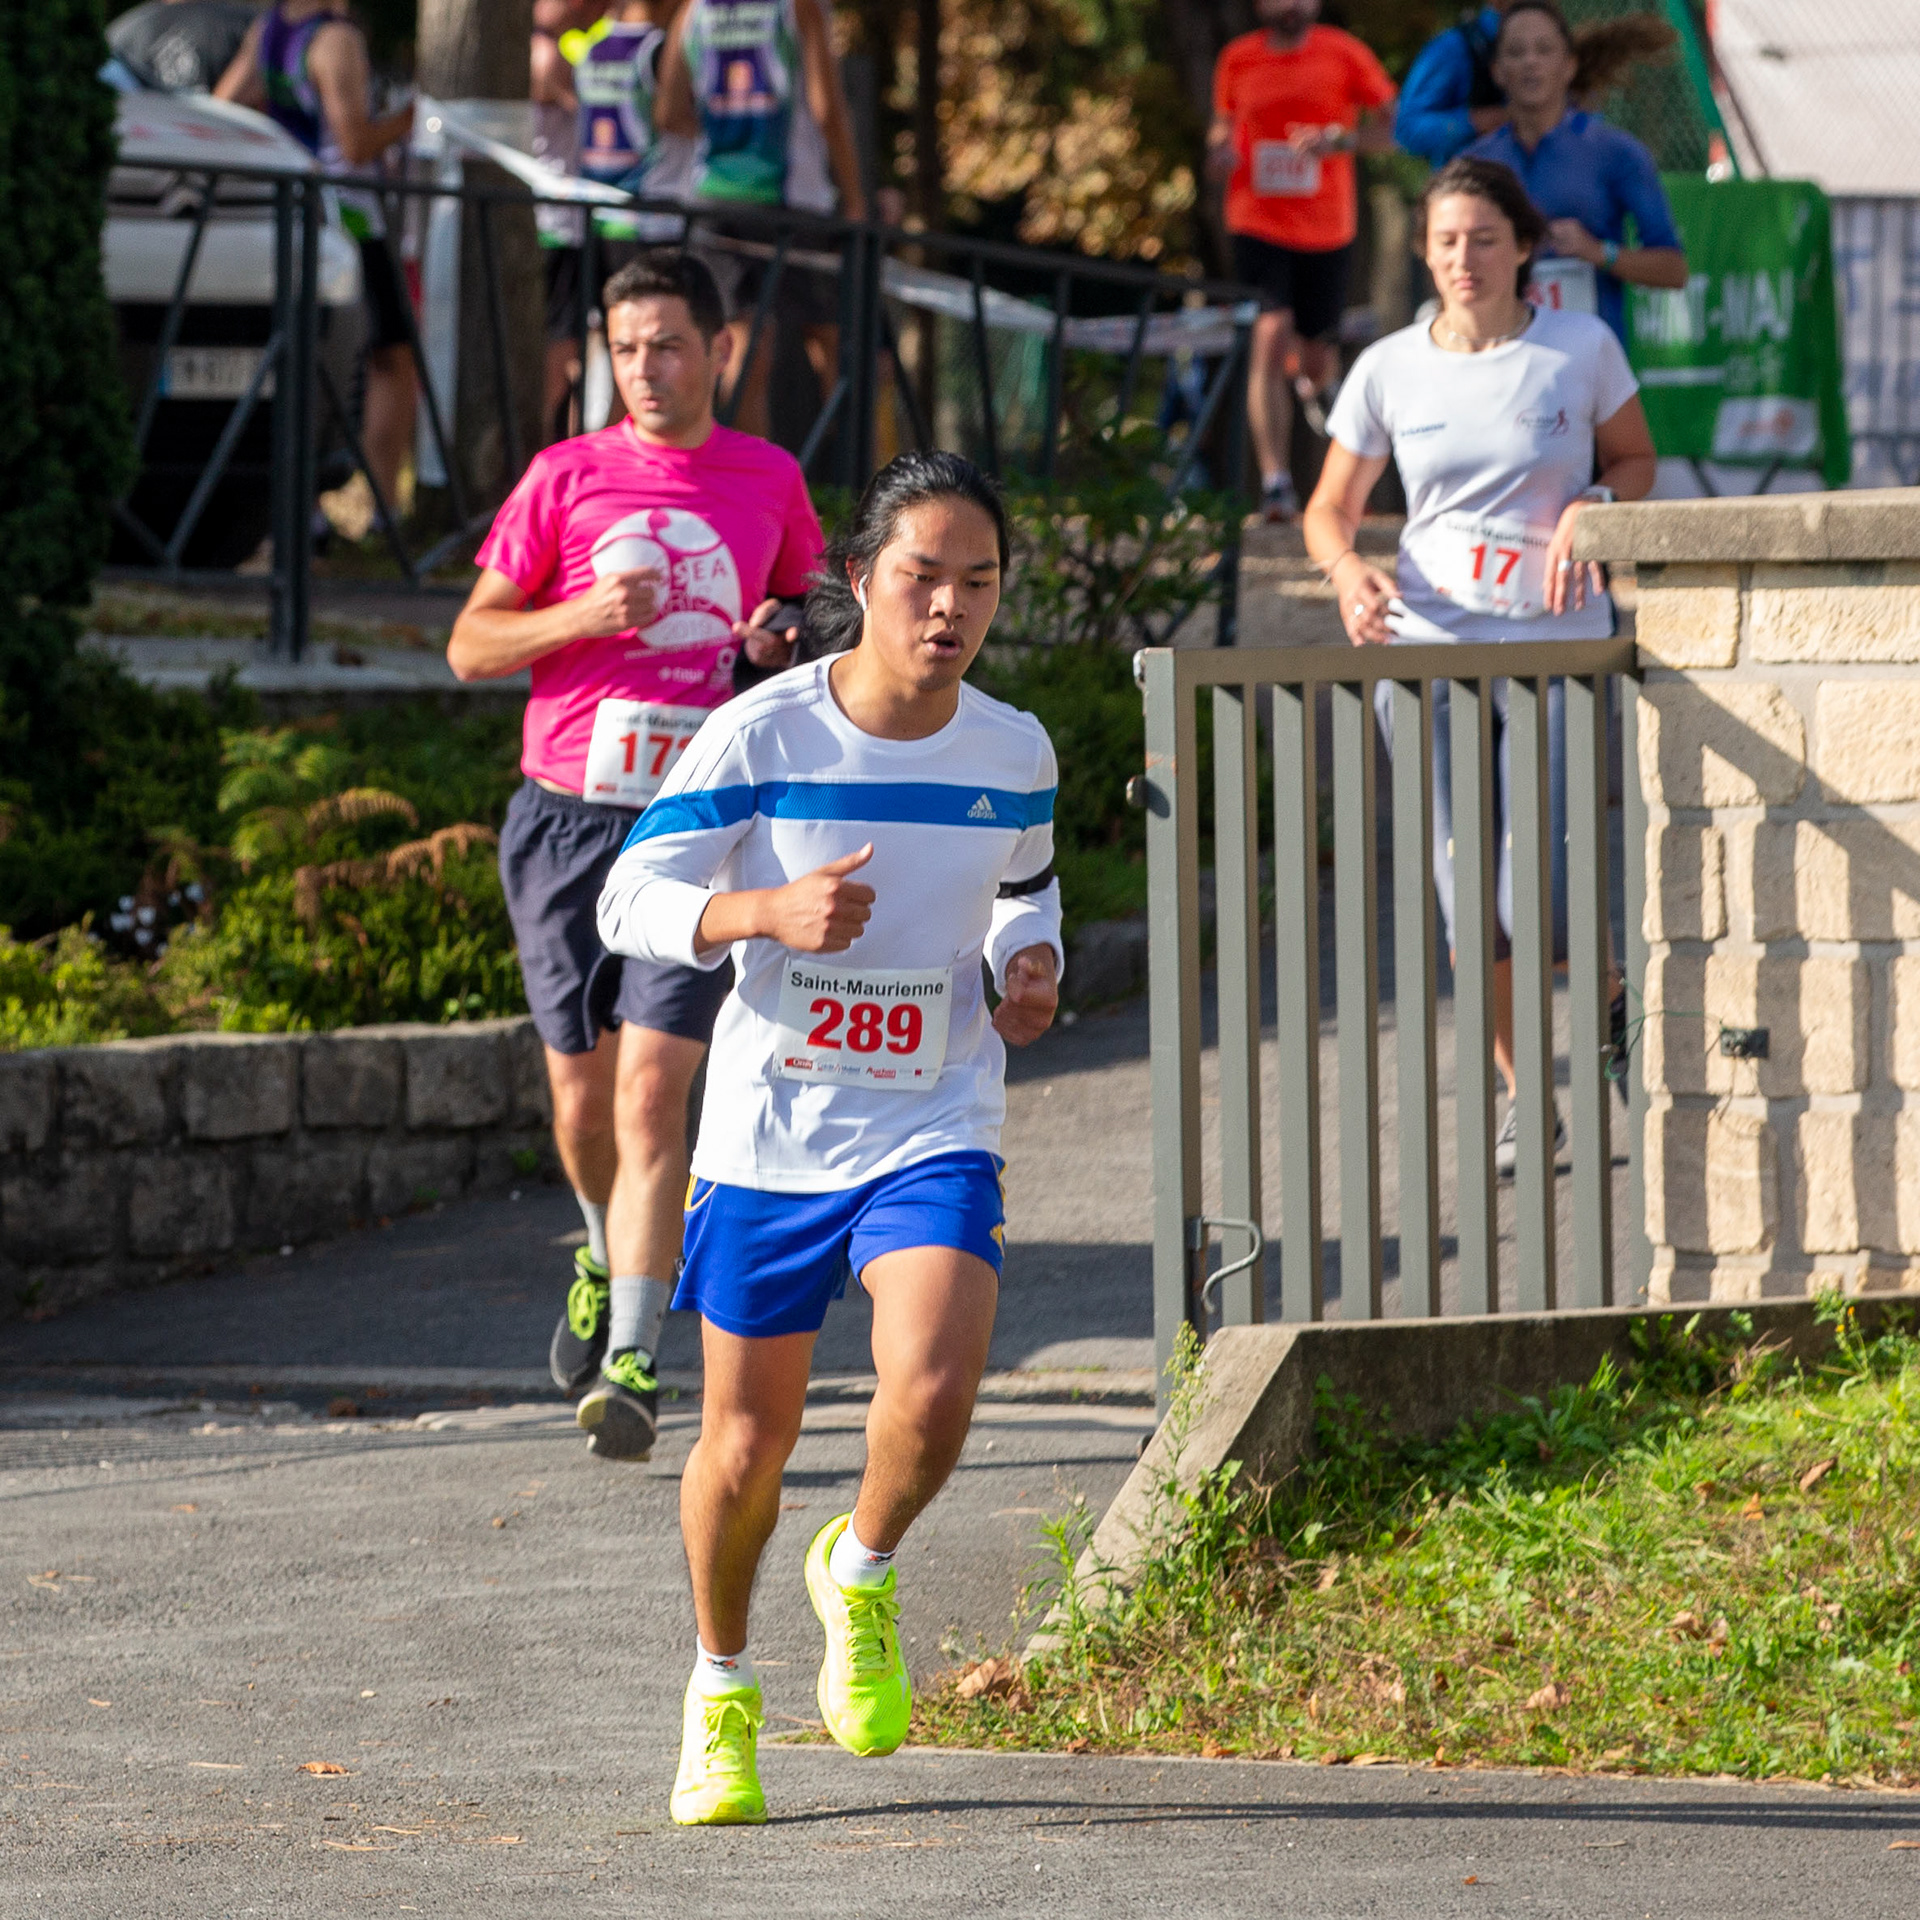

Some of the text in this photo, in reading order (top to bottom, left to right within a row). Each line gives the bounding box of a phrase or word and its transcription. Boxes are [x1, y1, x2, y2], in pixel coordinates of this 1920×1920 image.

[1470, 541, 1522, 585] 17
[967, 808, 997, 820] adidas
[791, 971, 943, 997] Saint-Maurienne
[807, 997, 922, 1055] 289
